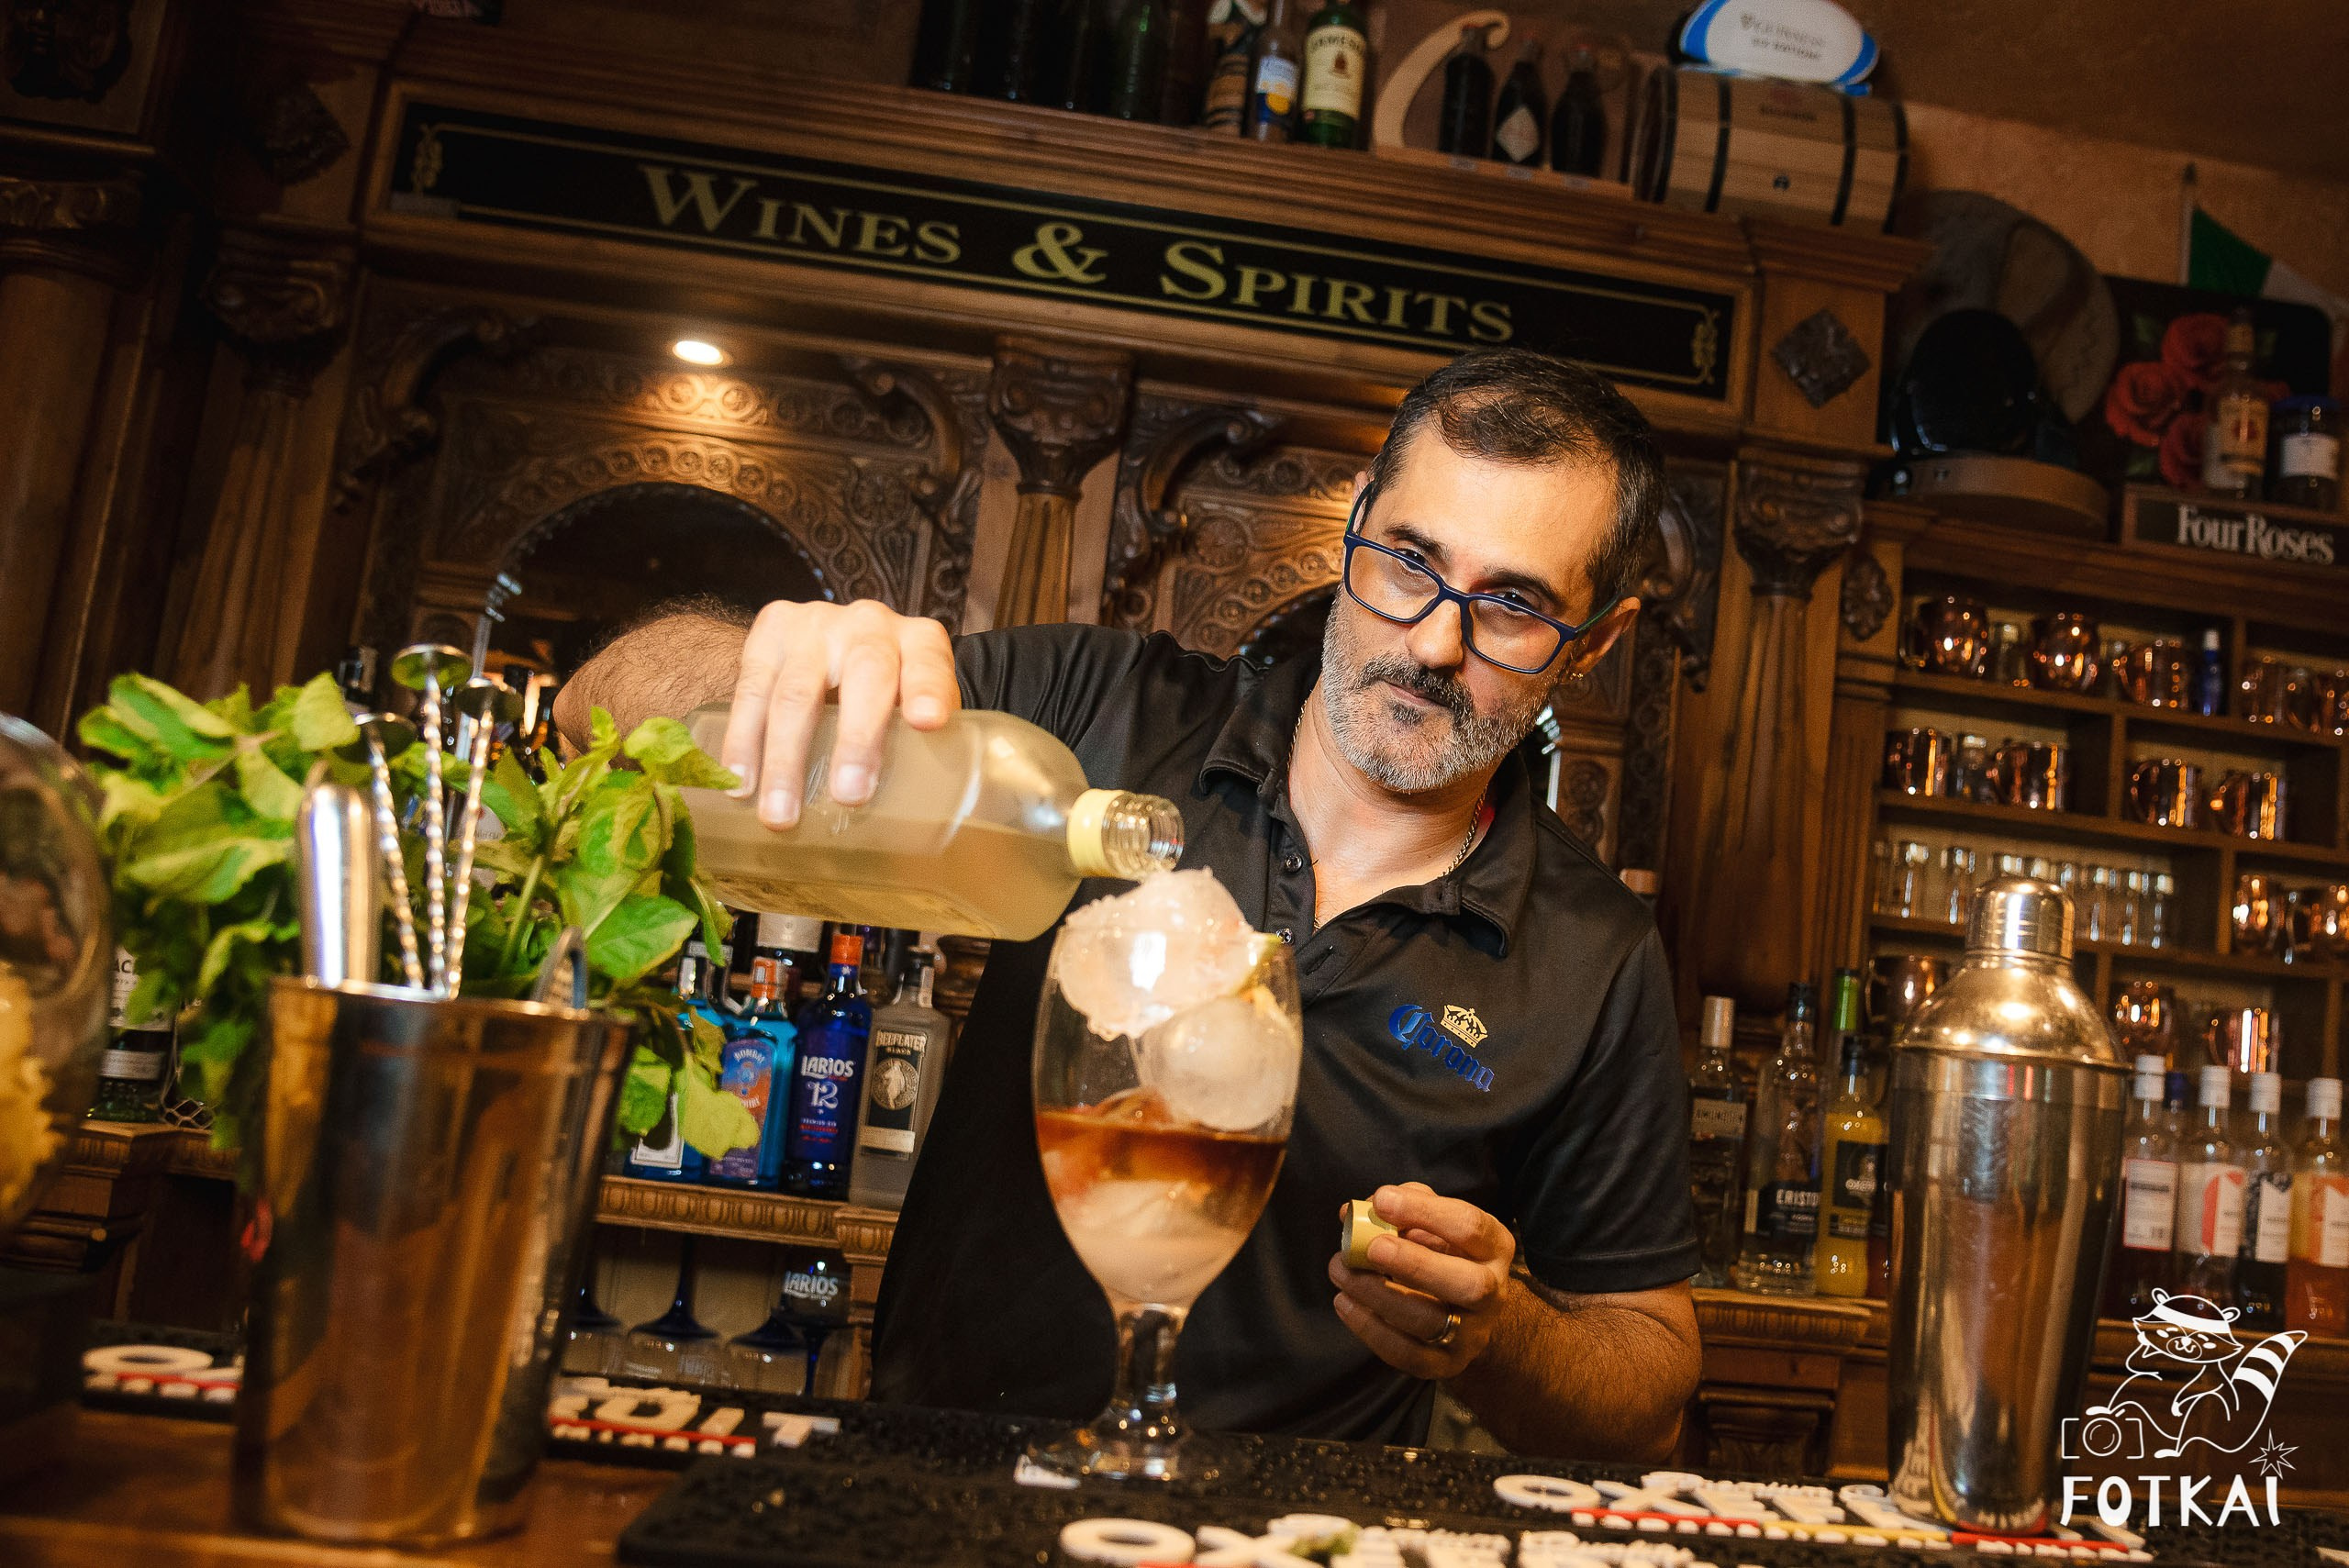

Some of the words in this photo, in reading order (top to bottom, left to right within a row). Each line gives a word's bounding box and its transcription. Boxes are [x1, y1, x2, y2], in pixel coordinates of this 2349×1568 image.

[639, 163, 963, 265] WINES
[1012, 221, 1108, 284] &
[1160, 239, 1515, 344] SPIRITS
[1387, 1004, 1496, 1093] Corona
[800, 1054, 855, 1080] LARIOS
[807, 1081, 839, 1109] 12
[784, 1271, 839, 1299] LARIOS
